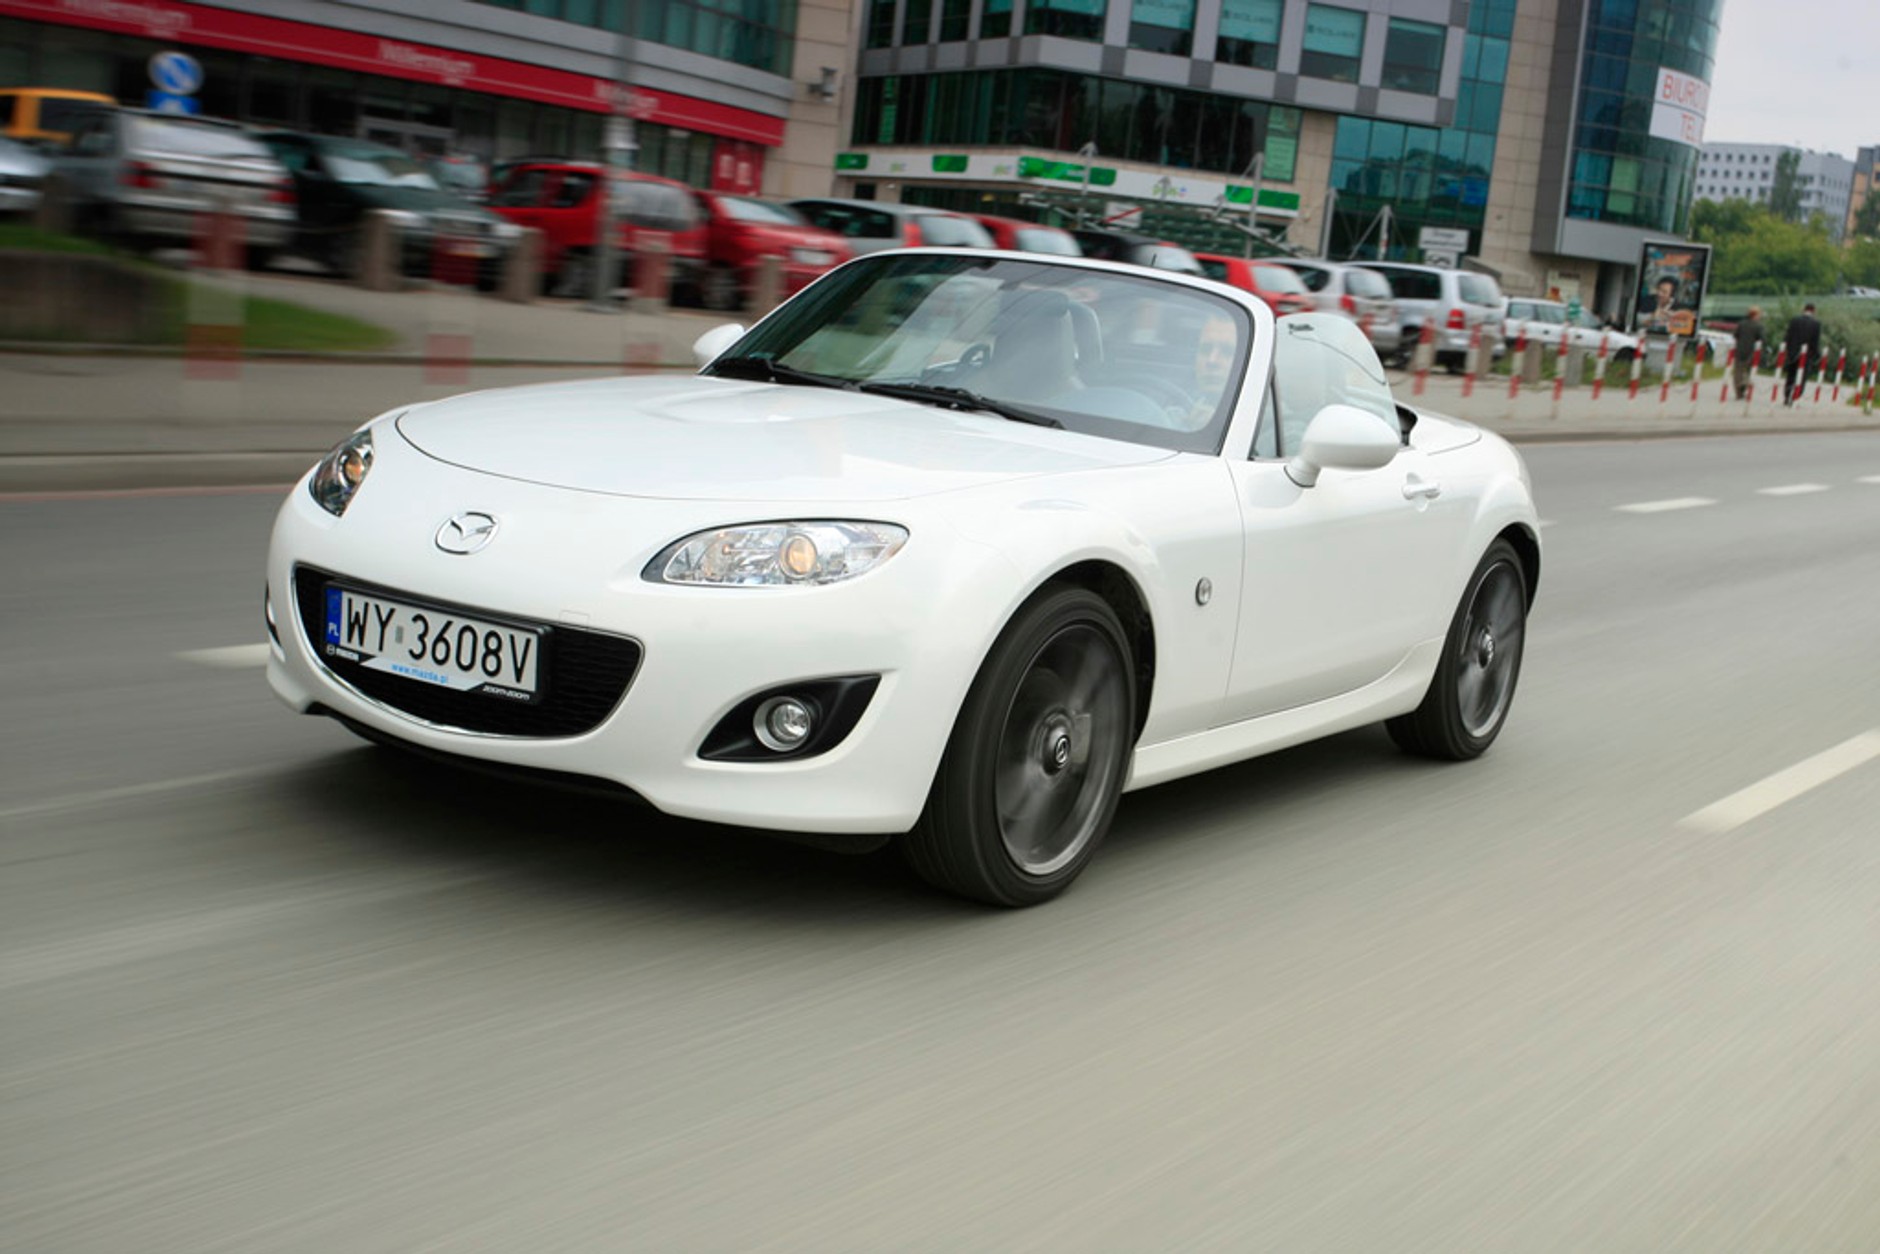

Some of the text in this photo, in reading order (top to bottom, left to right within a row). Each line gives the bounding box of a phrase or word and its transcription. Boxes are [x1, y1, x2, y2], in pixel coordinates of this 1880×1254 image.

[328, 622, 340, 637] PL
[347, 598, 532, 683] WY 3608V
[391, 664, 449, 685] www.mazda.pl
